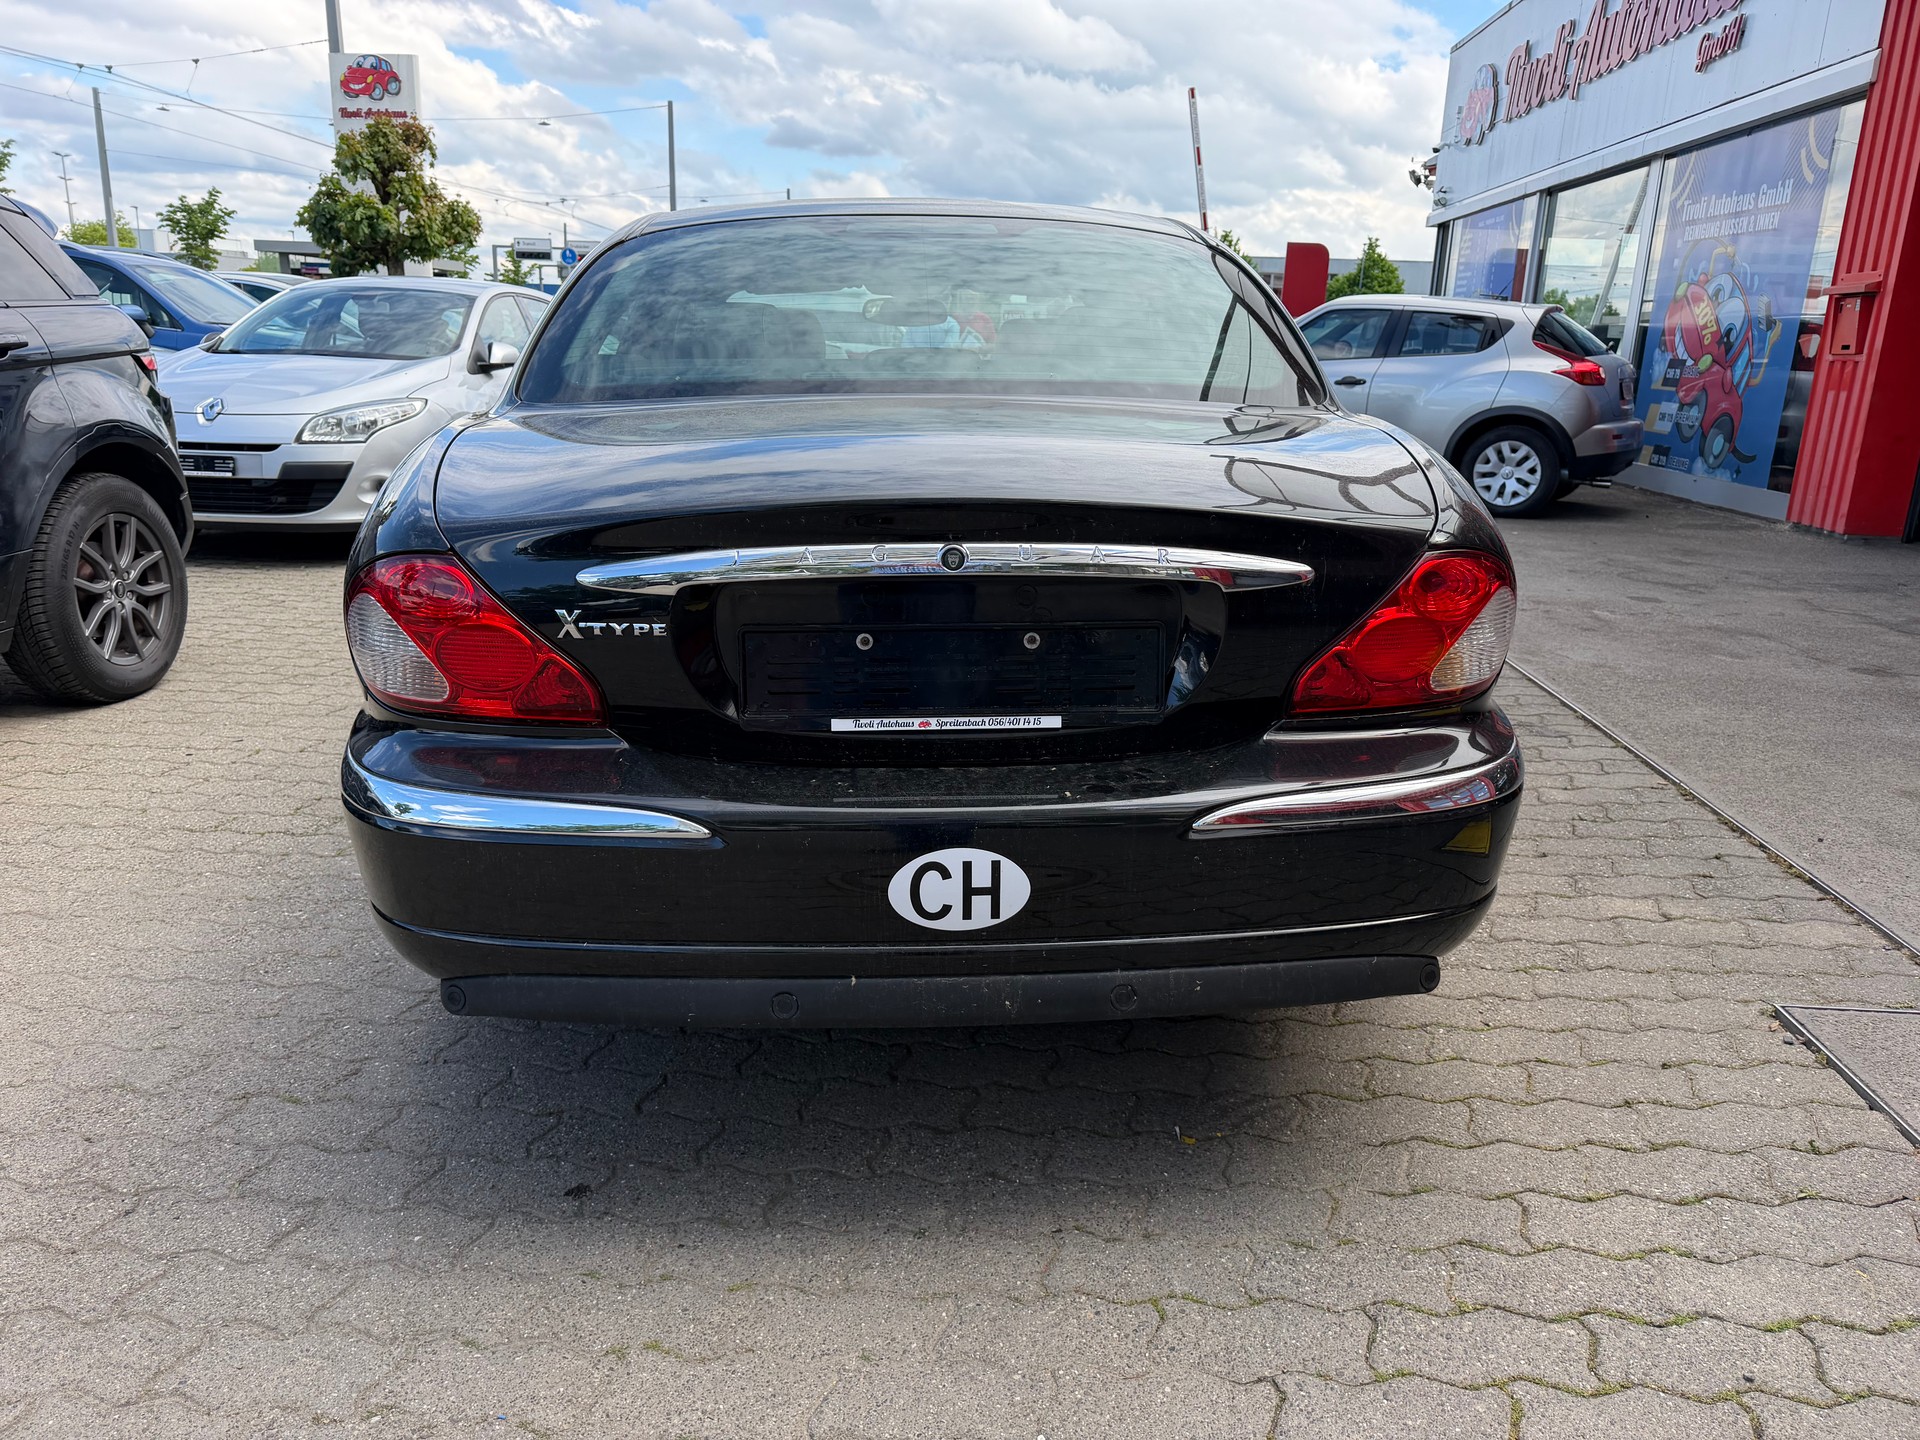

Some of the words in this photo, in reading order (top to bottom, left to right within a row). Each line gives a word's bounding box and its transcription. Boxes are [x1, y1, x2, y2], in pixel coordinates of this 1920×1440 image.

[1695, 13, 1746, 74] GmbH
[1504, 19, 1576, 122] Tivoli
[338, 107, 363, 118] Tivoli
[1682, 196, 1708, 222] Tivoli
[1708, 190, 1755, 217] Autohaus
[1758, 179, 1793, 208] GmbH
[1684, 223, 1720, 242] REINIGUNG
[1720, 217, 1747, 236] AUSSEN
[1748, 215, 1755, 231] &
[1756, 211, 1781, 232] INNEN
[1694, 295, 1717, 346] 30%
[731, 543, 1172, 568] JAGUAR
[852, 718, 874, 729] Tivoli
[875, 718, 915, 730] Autohaus
[935, 718, 986, 730] Spreitenbach
[987, 717, 1021, 728] 056/401
[1022, 717, 1031, 727] 14
[1032, 717, 1042, 727] 15
[909, 859, 1002, 921] CH
